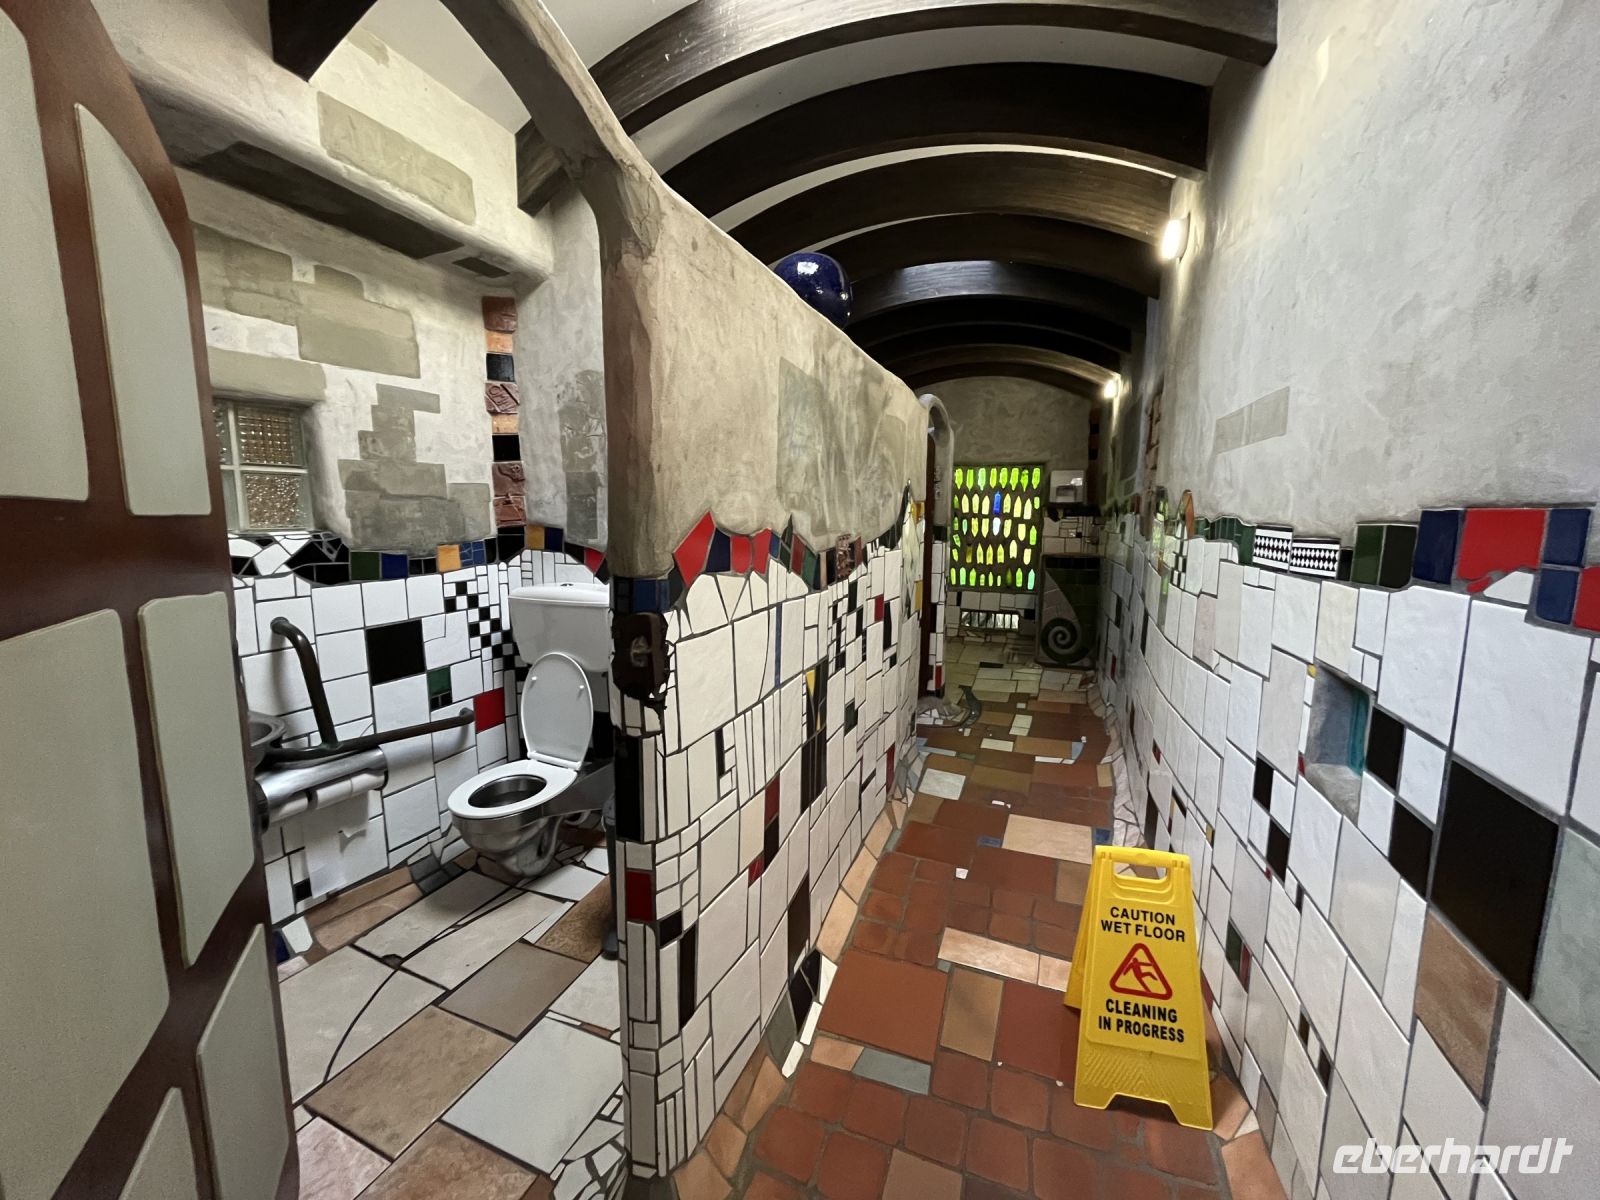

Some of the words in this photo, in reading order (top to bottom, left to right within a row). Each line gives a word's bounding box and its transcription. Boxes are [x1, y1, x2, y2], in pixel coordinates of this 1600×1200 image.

[1110, 906, 1175, 925] CAUTION
[1101, 920, 1129, 935] WET
[1135, 924, 1185, 942] FLOOR
[1105, 998, 1178, 1023] CLEANING
[1098, 1015, 1112, 1030] IN
[1116, 1018, 1185, 1043] PROGRESS
